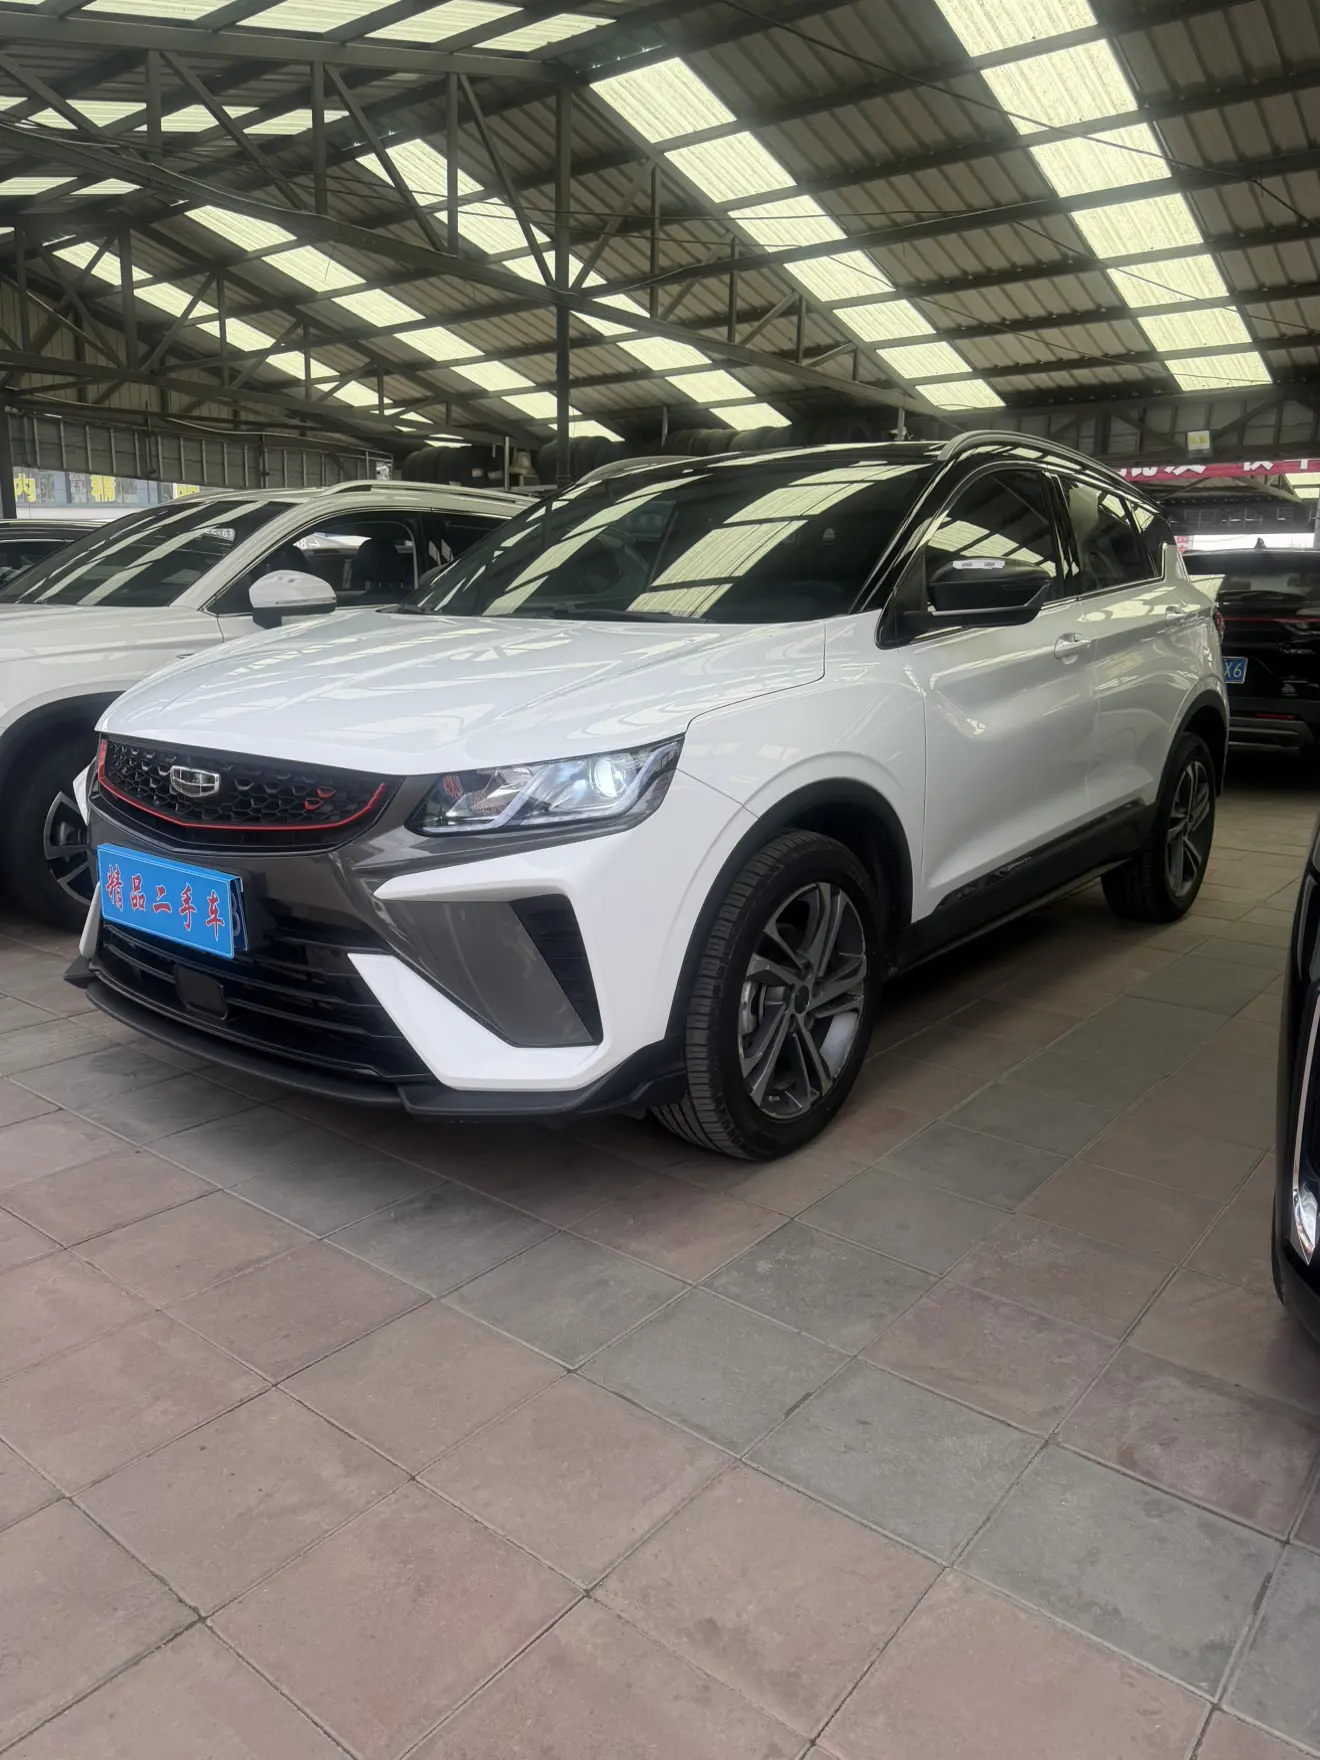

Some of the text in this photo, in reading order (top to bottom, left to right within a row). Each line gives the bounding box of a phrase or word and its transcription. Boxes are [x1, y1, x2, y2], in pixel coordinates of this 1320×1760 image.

[106, 864, 225, 942] 精品二手车
